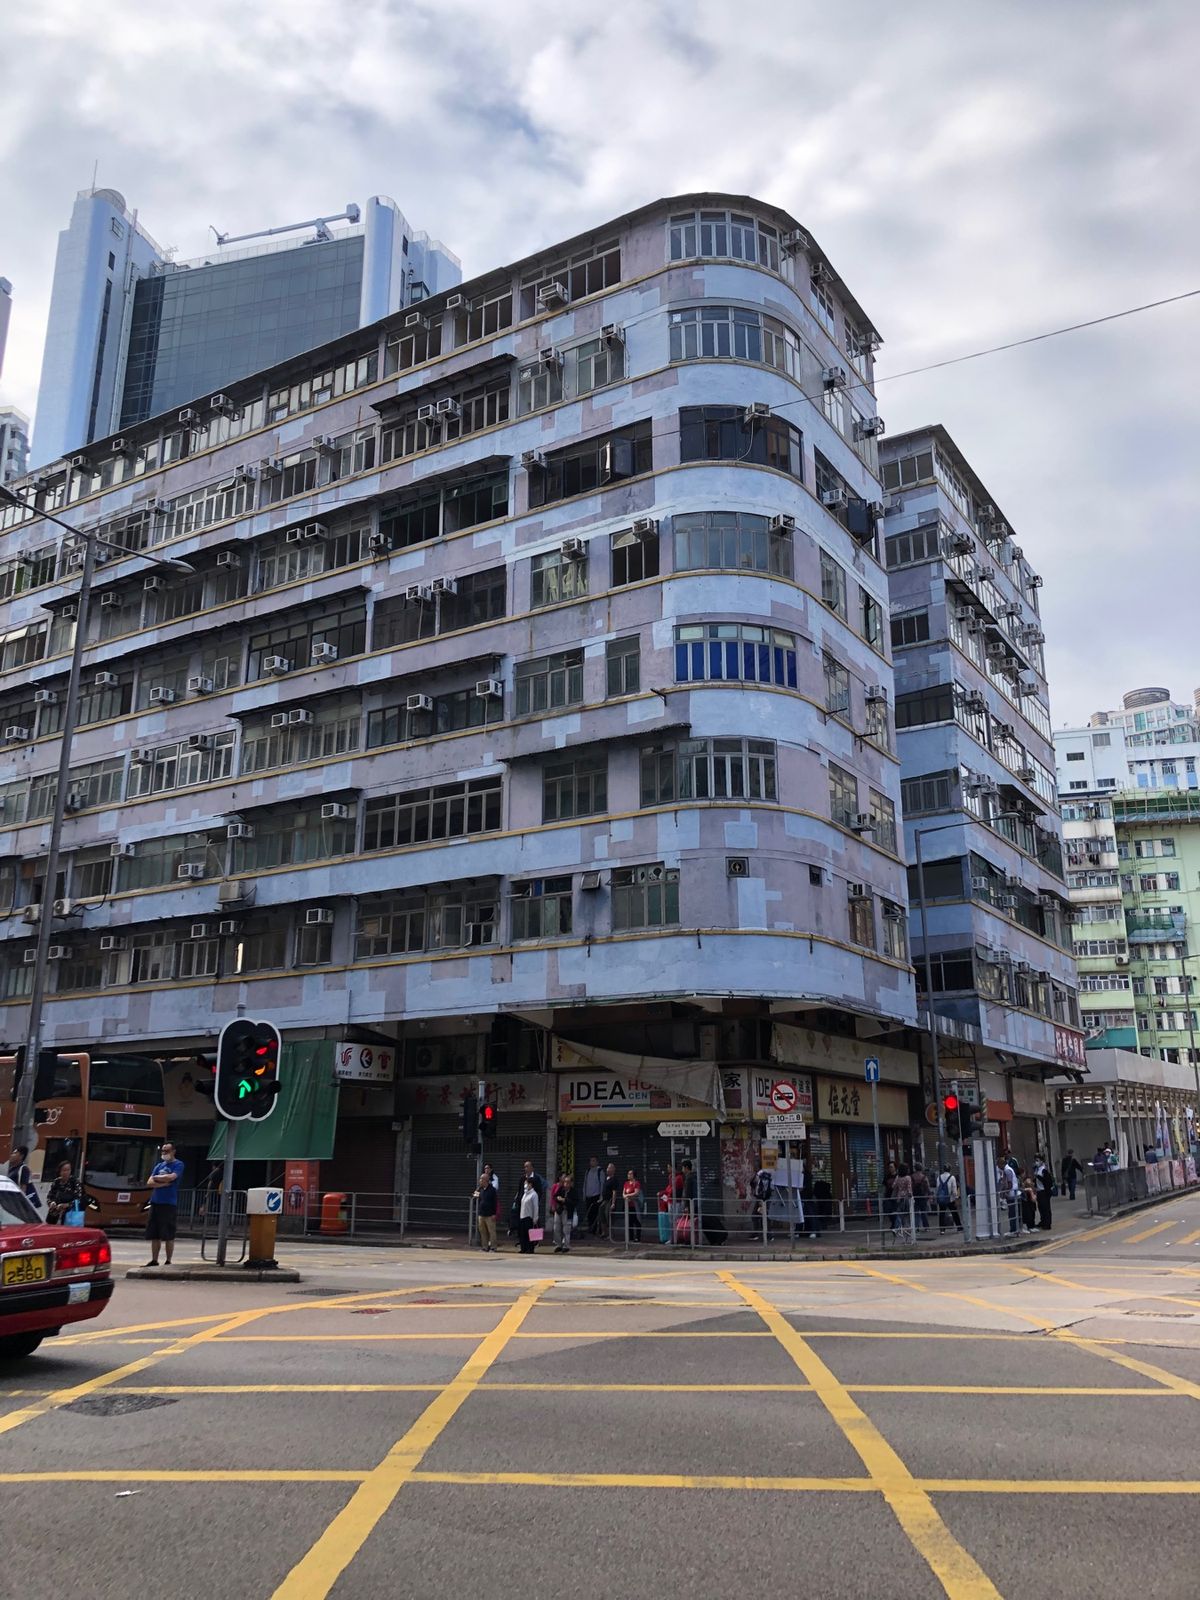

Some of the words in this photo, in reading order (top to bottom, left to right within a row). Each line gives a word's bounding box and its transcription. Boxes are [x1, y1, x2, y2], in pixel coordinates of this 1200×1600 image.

[569, 1080, 626, 1102] IDEA
[21, 1256, 33, 1269] JX
[7, 1267, 42, 1283] 2560
